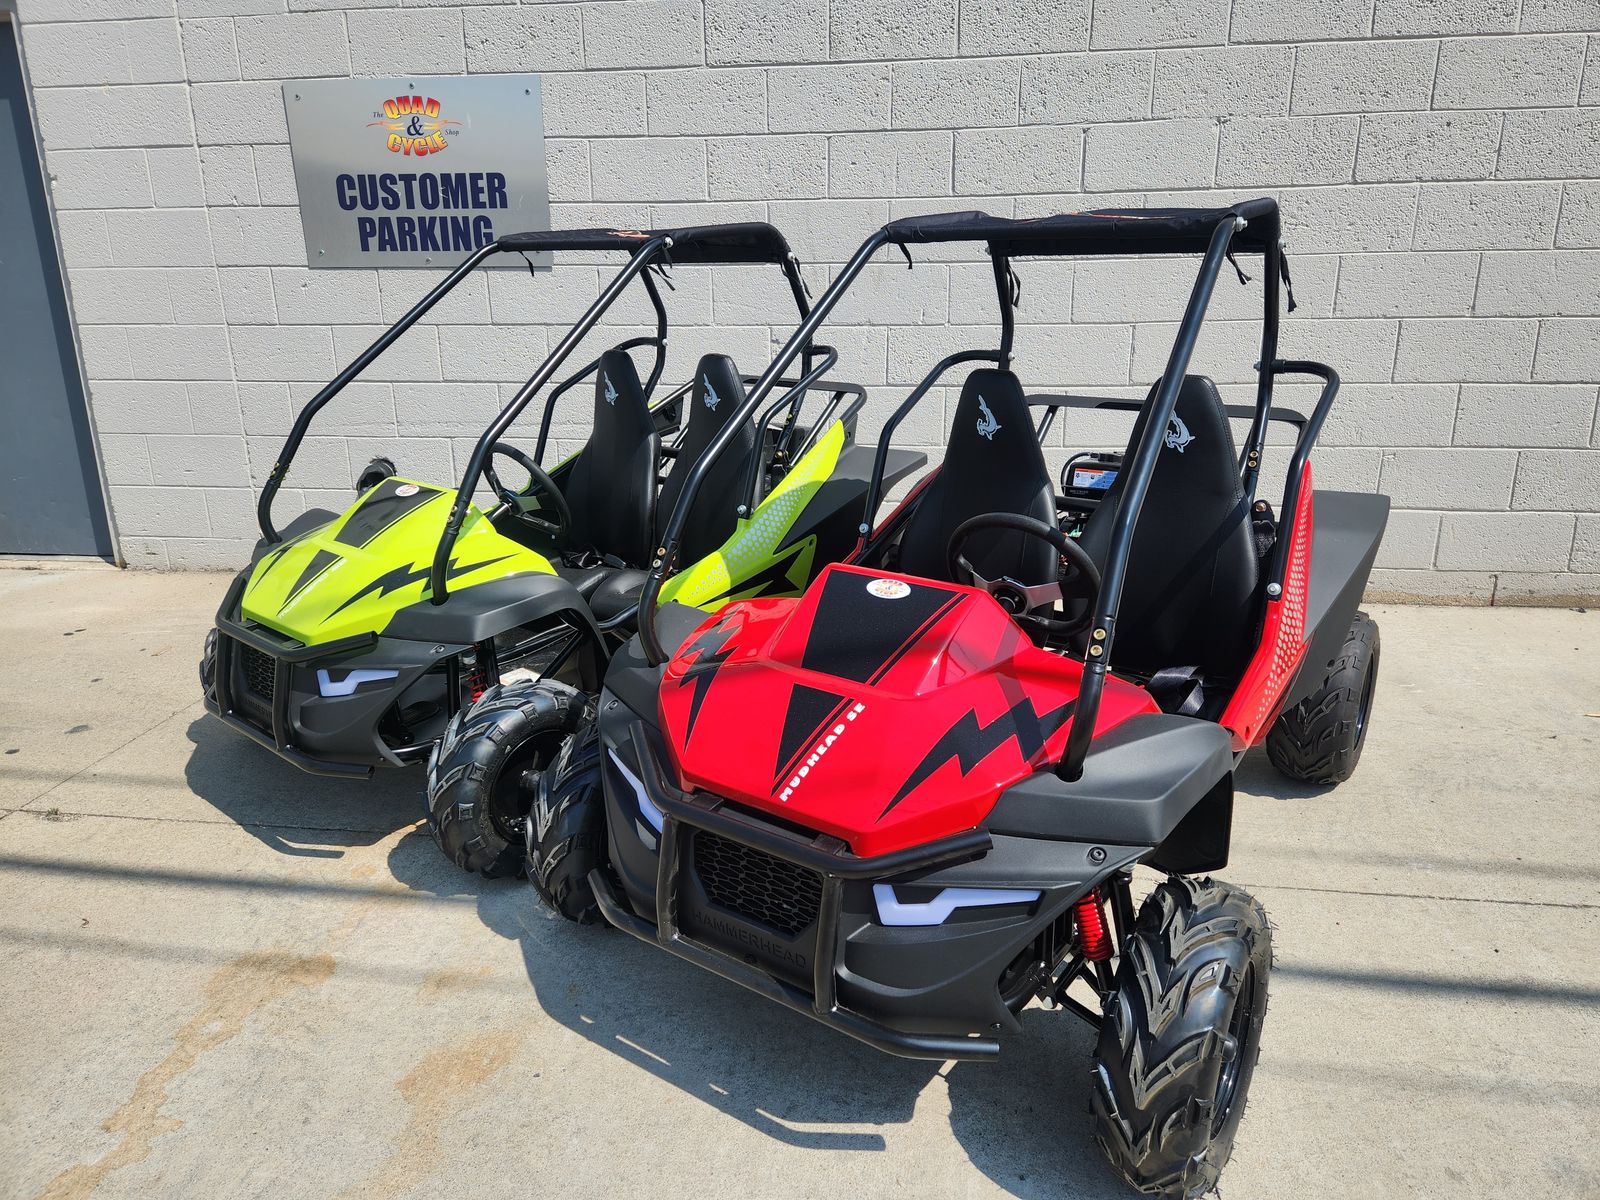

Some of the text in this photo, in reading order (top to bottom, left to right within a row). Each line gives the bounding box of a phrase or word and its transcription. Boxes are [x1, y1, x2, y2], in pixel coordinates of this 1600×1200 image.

[383, 95, 441, 119] QUAD
[406, 115, 424, 136] &
[386, 130, 448, 157] CYCLE
[335, 172, 508, 210] CUSTOMER
[357, 215, 494, 252] PARKING
[779, 702, 866, 802] MUDHEAD SE
[691, 908, 807, 969] HAMMERHEAD
